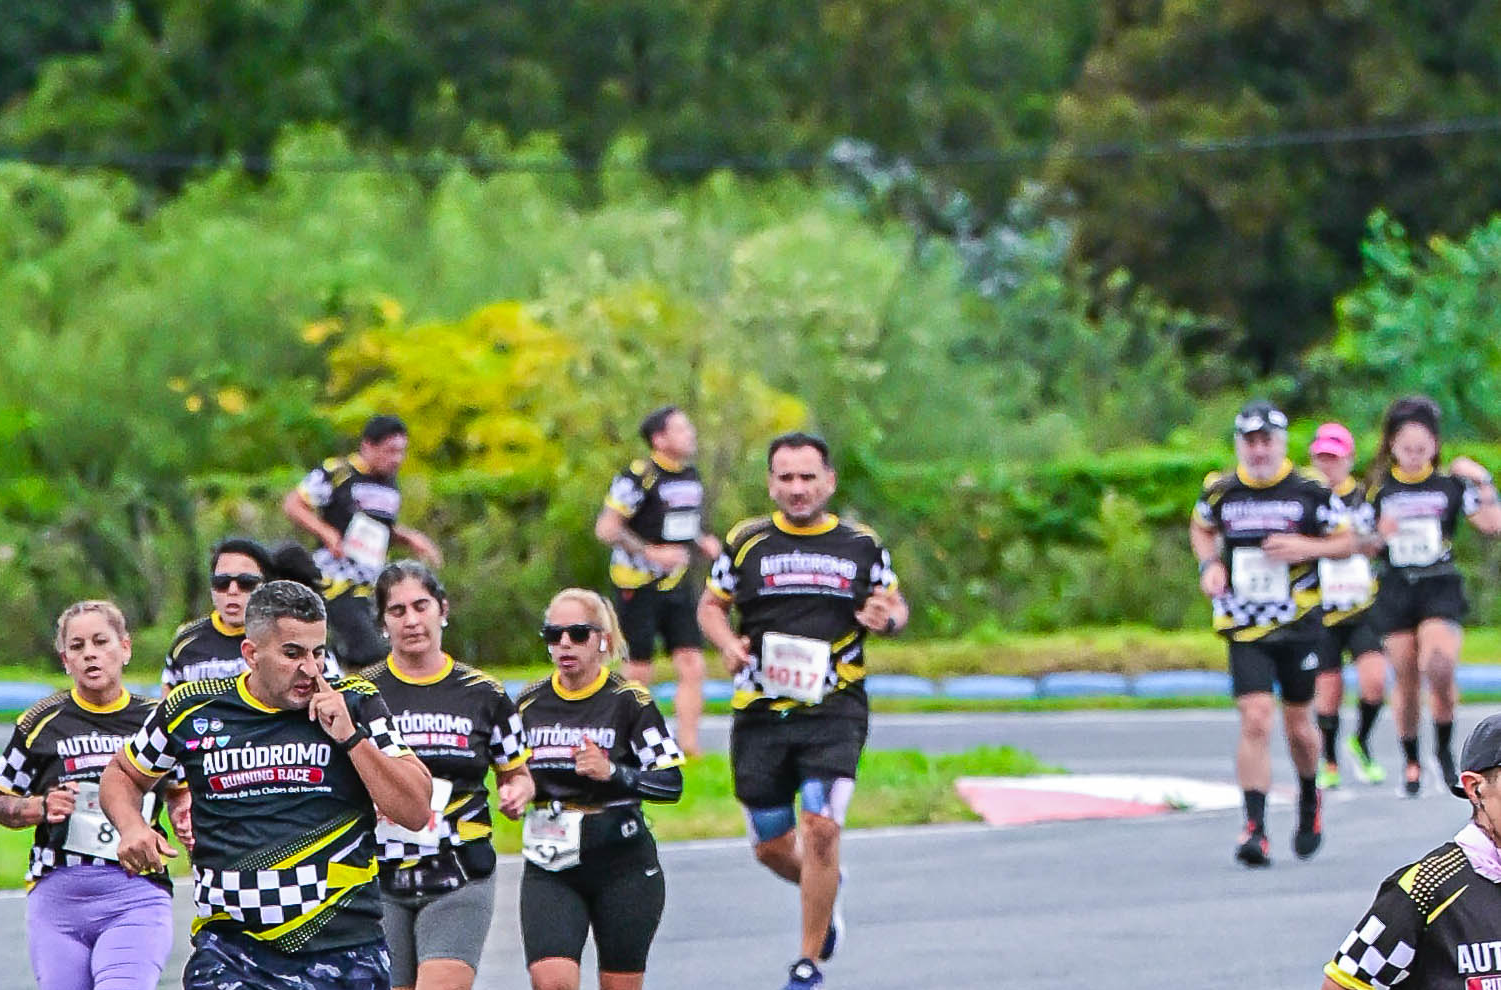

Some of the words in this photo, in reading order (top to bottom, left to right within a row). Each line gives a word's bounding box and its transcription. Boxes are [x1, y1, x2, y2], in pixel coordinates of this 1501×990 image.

[391, 709, 473, 736] TÓDROMO
[57, 731, 125, 757] AUTÓDR
[202, 741, 331, 776] AUTÓDROMO
[219, 768, 275, 790] RUNNING
[277, 768, 311, 782] RACE
